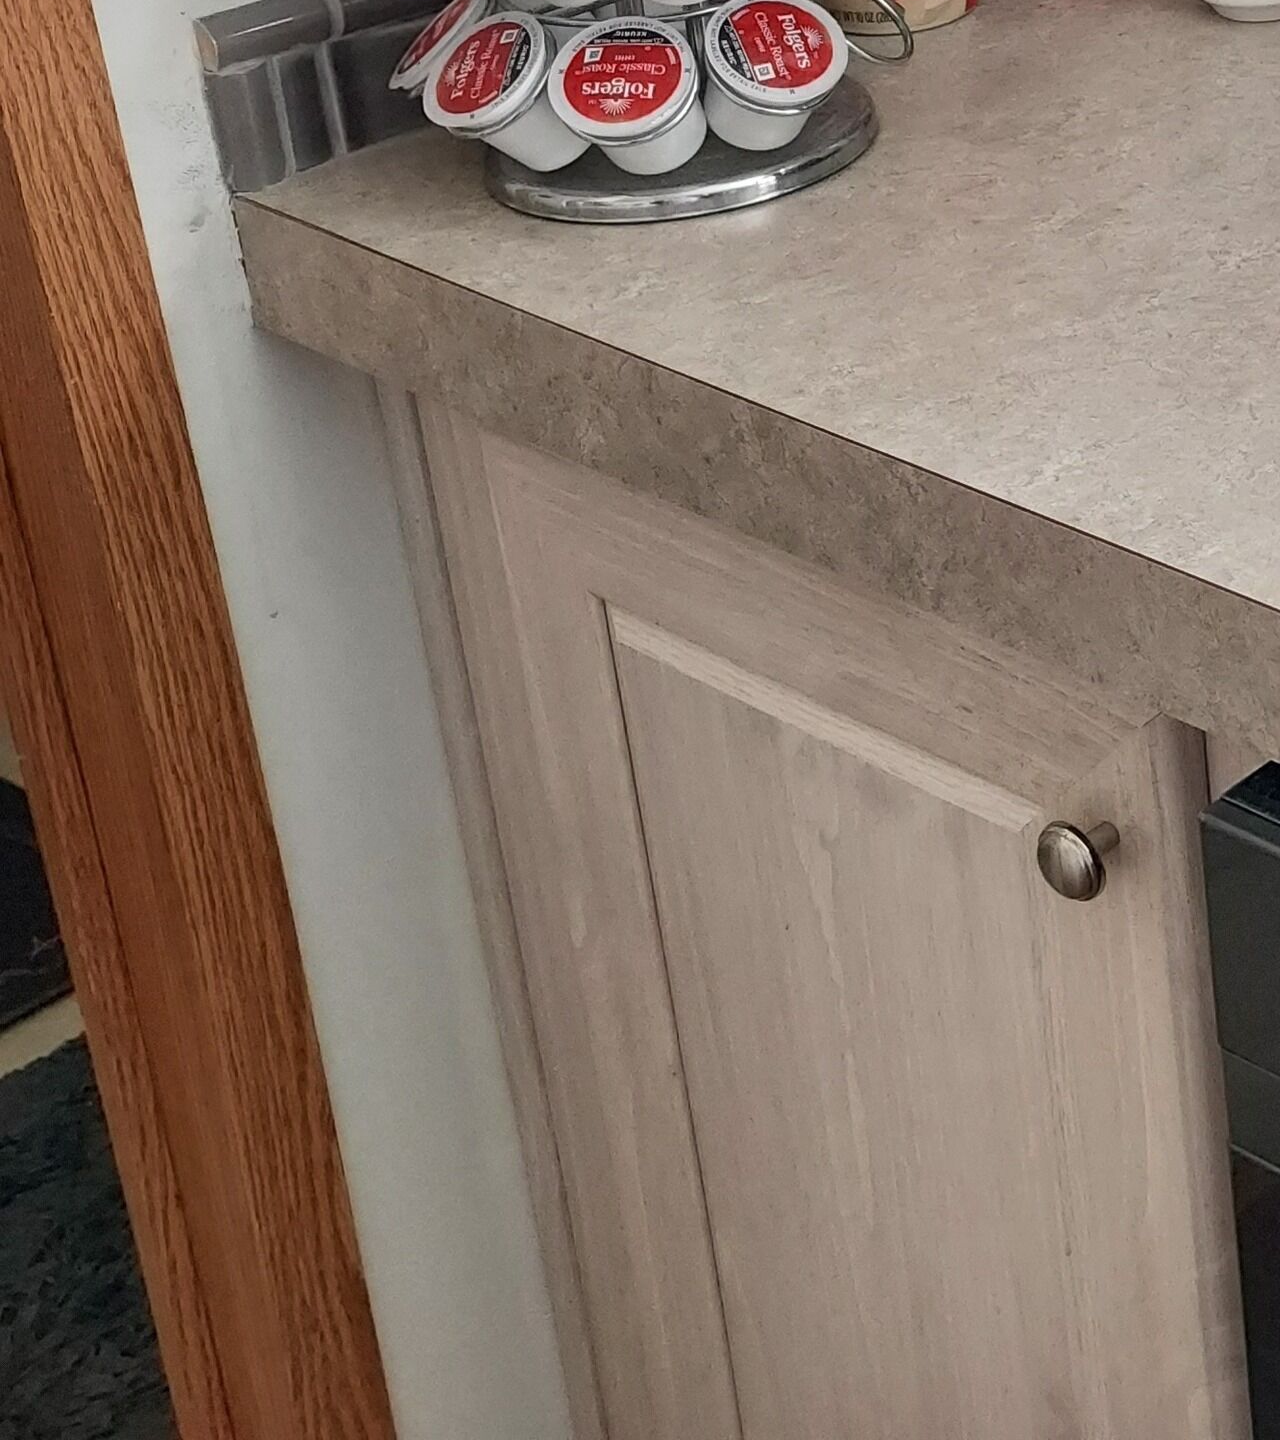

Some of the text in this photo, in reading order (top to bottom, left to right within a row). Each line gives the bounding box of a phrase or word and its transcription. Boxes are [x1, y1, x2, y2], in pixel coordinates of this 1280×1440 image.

[752, 9, 789, 76] Classic Roast
[777, 9, 812, 69] Folgers
[449, 38, 481, 99] Folgers
[468, 60, 489, 100] Classic
[581, 63, 666, 75] Classic Roast
[581, 76, 654, 98] Folgers
